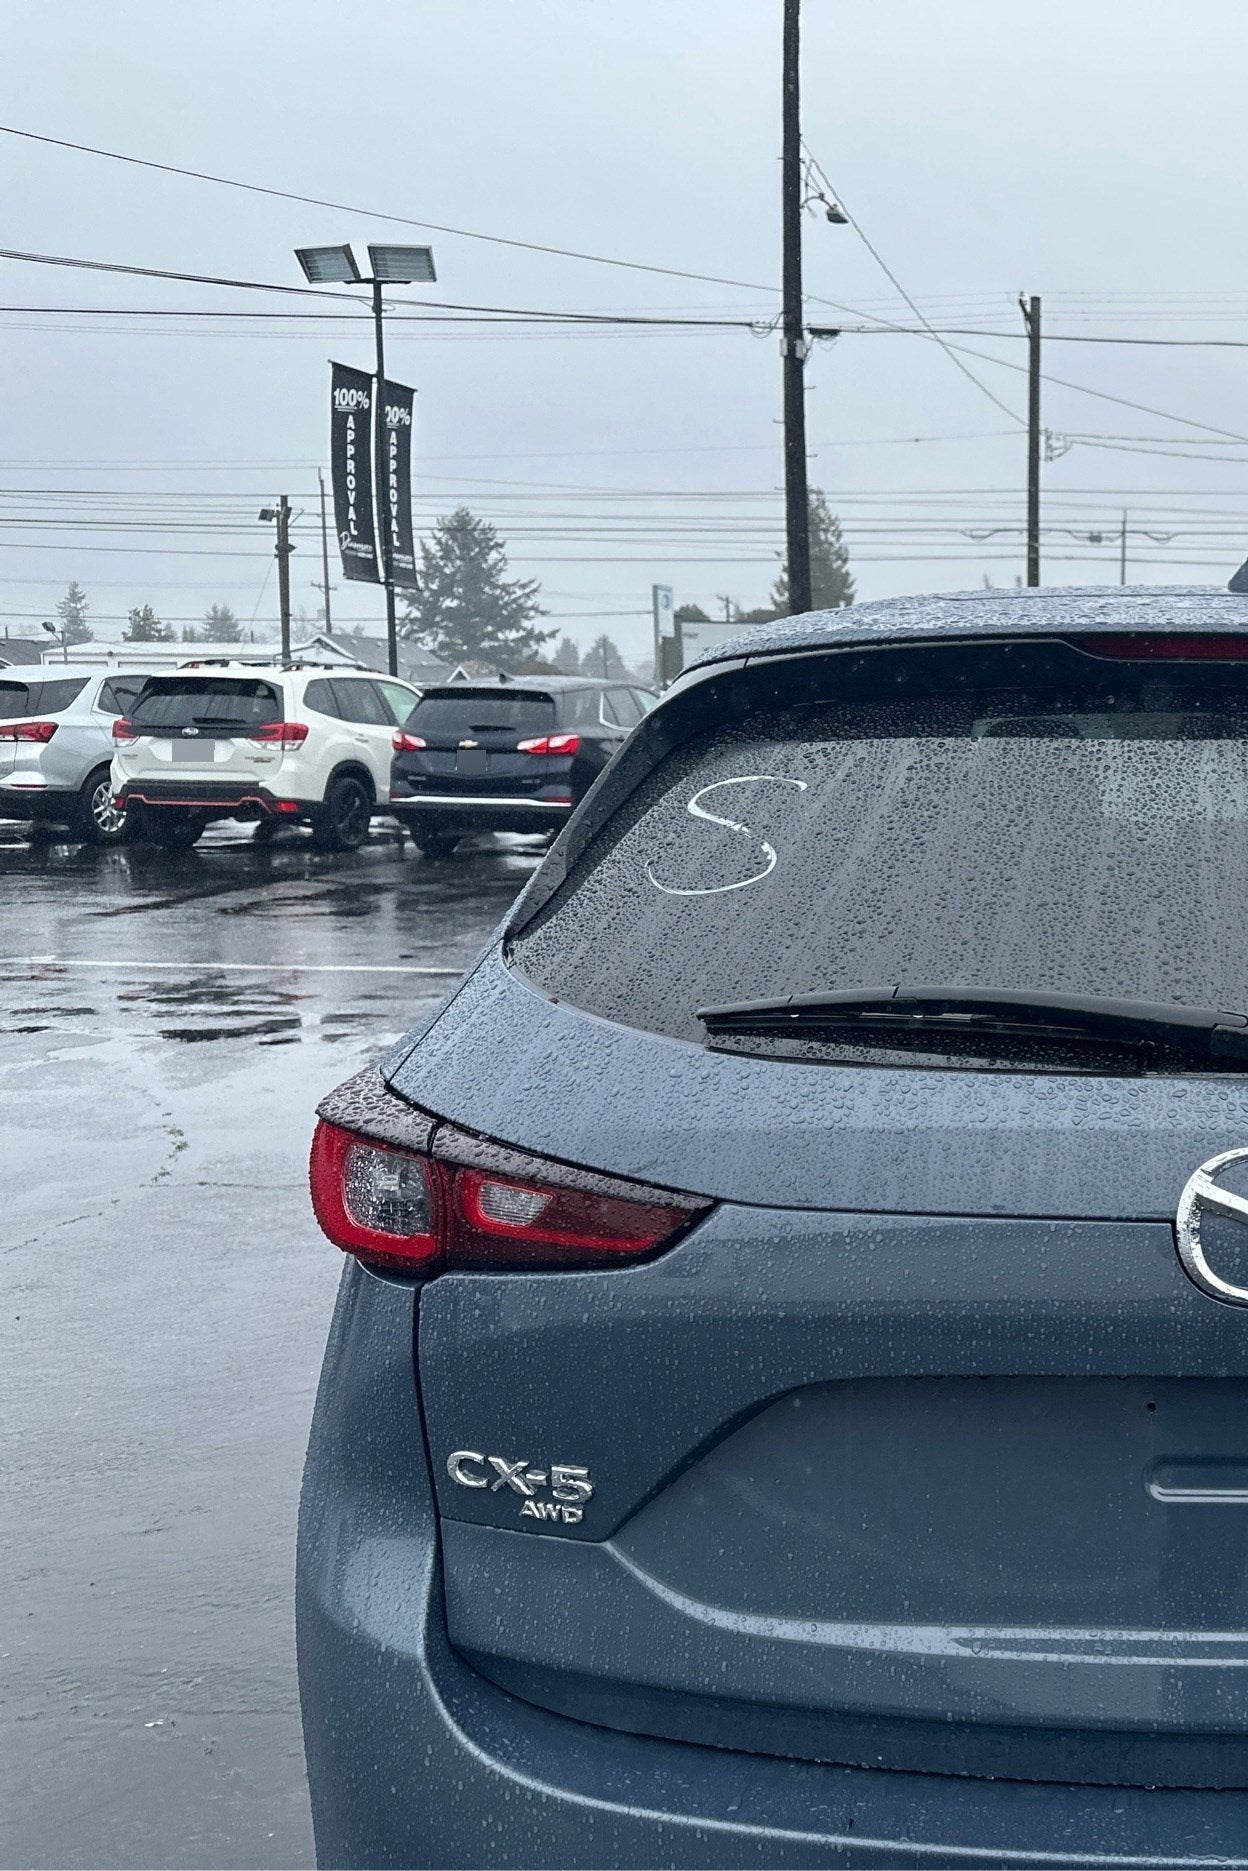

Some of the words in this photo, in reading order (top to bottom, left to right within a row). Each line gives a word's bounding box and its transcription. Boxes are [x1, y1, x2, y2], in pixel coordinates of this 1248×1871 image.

[334, 388, 370, 409] 100%
[346, 415, 358, 536] APPROVAL
[389, 431, 400, 547] APPROVAL
[644, 775, 808, 896] S
[446, 1450, 595, 1503] CX-5
[518, 1499, 584, 1524] AWD
